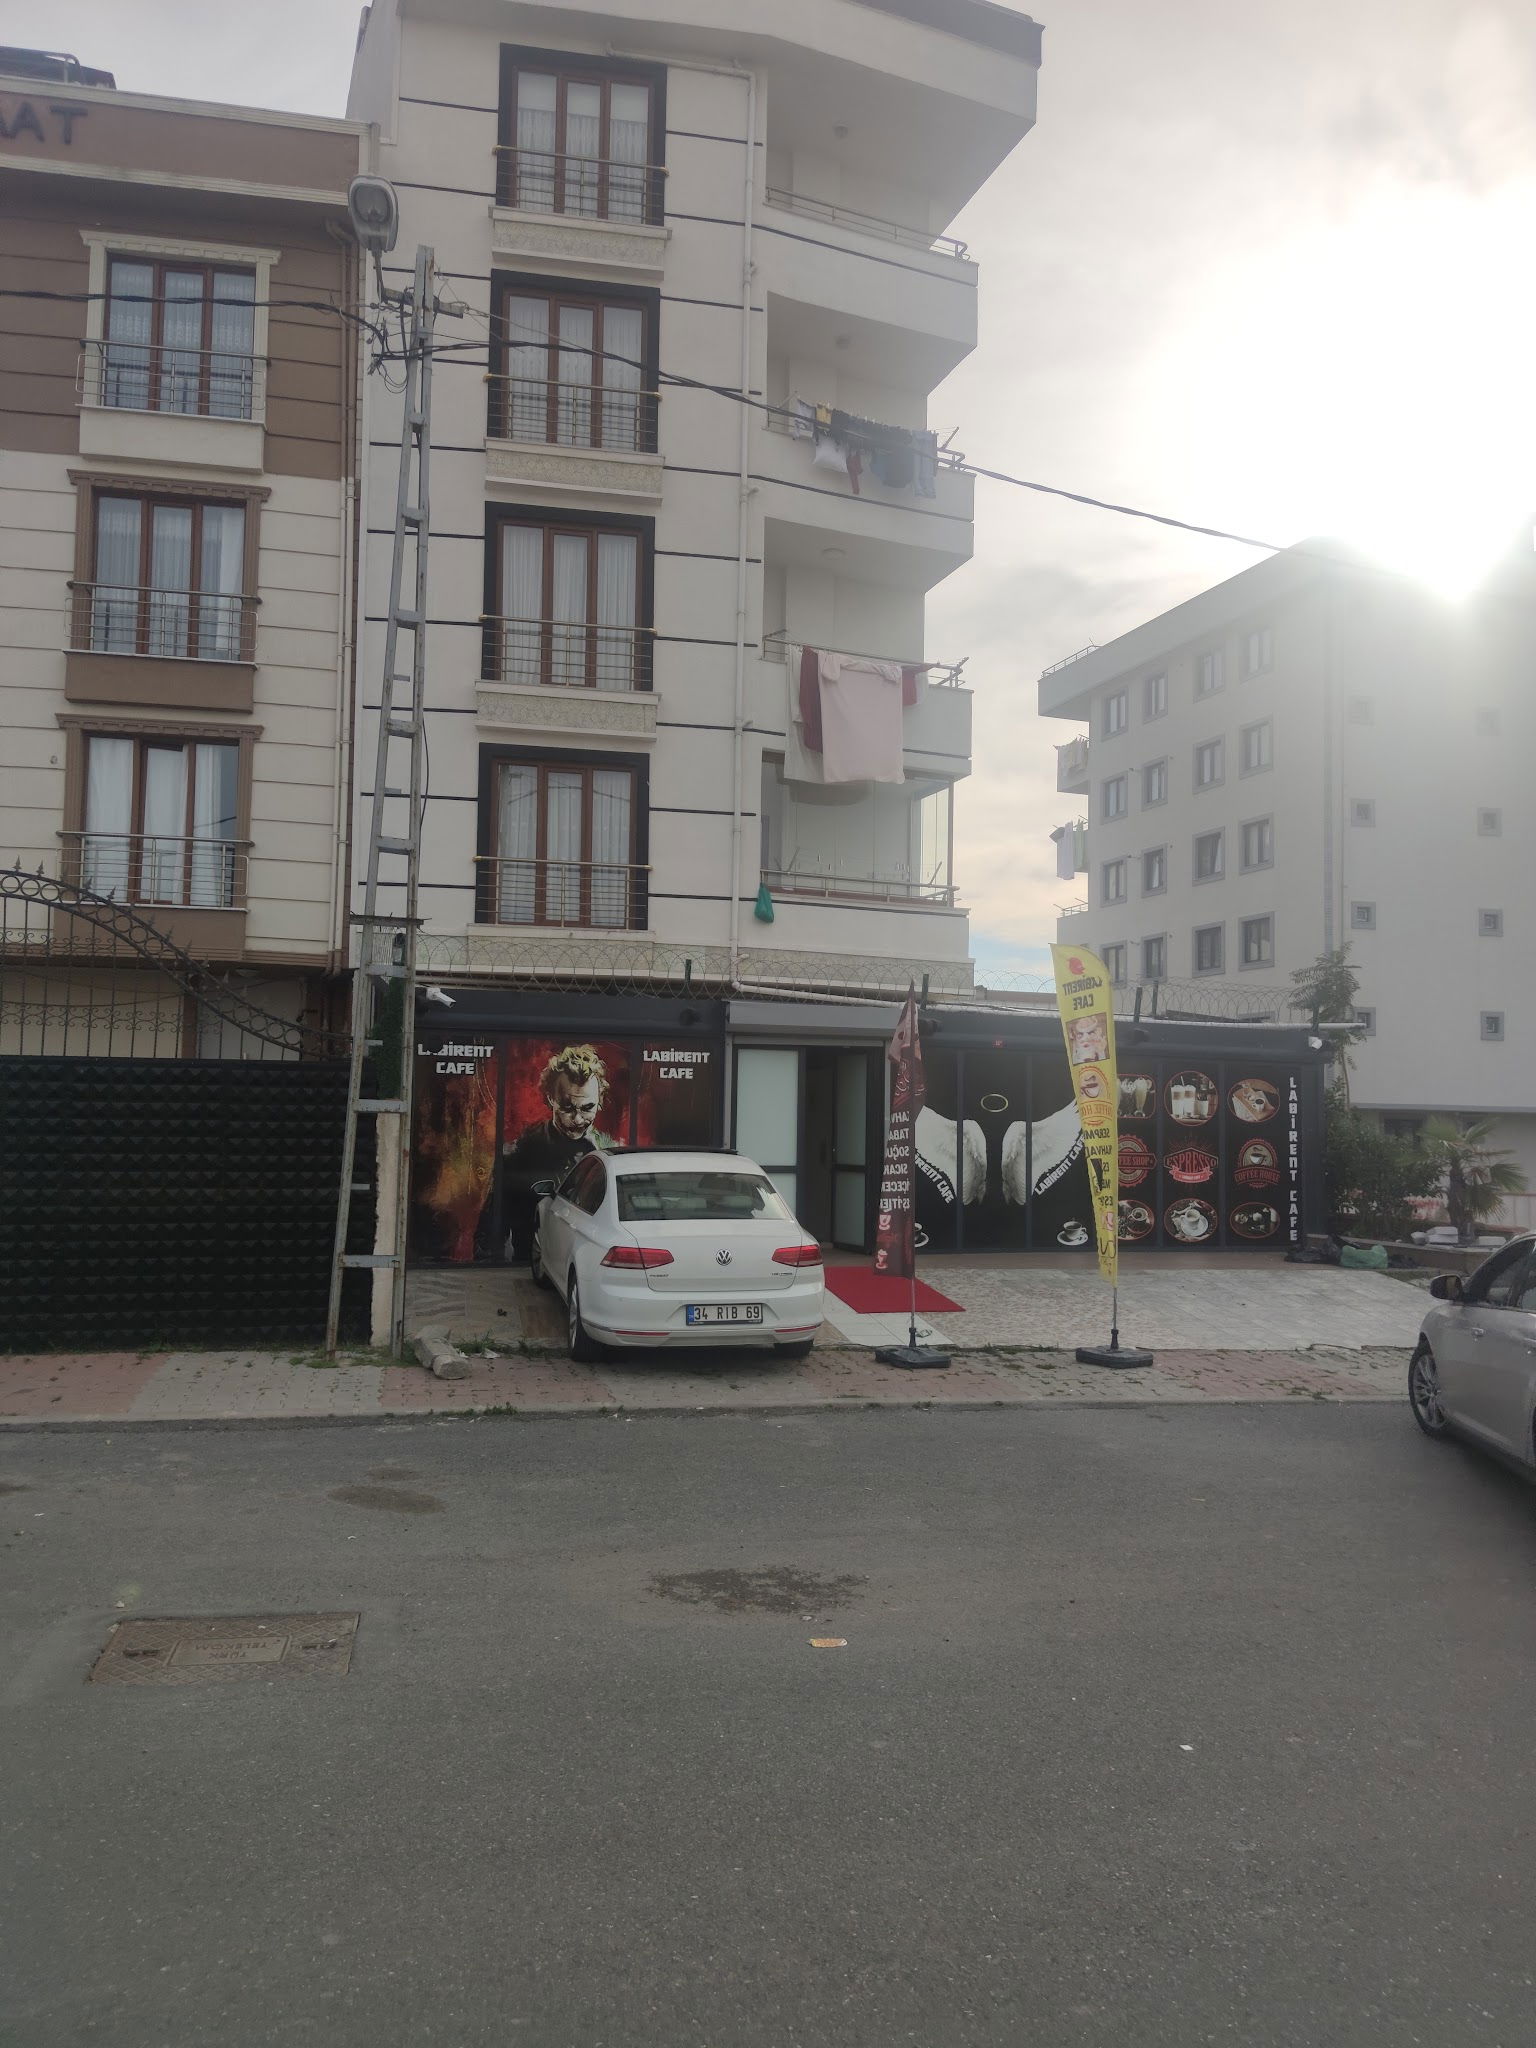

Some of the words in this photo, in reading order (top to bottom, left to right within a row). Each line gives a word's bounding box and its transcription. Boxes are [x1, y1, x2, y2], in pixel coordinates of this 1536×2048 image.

[0, 102, 89, 146] AT
[643, 1048, 711, 1063] LABİRENT
[436, 1062, 475, 1075] CAFE
[660, 1068, 694, 1080] CAFE
[1166, 1151, 1217, 1174] ESPRESSO
[1034, 1158, 1072, 1195] LABİRENT
[936, 1180, 955, 1204] CAFE
[1289, 1190, 1299, 1241] CAFE
[694, 1307, 708, 1320] 34
[717, 1306, 738, 1320] RIB
[746, 1306, 760, 1319] 69
